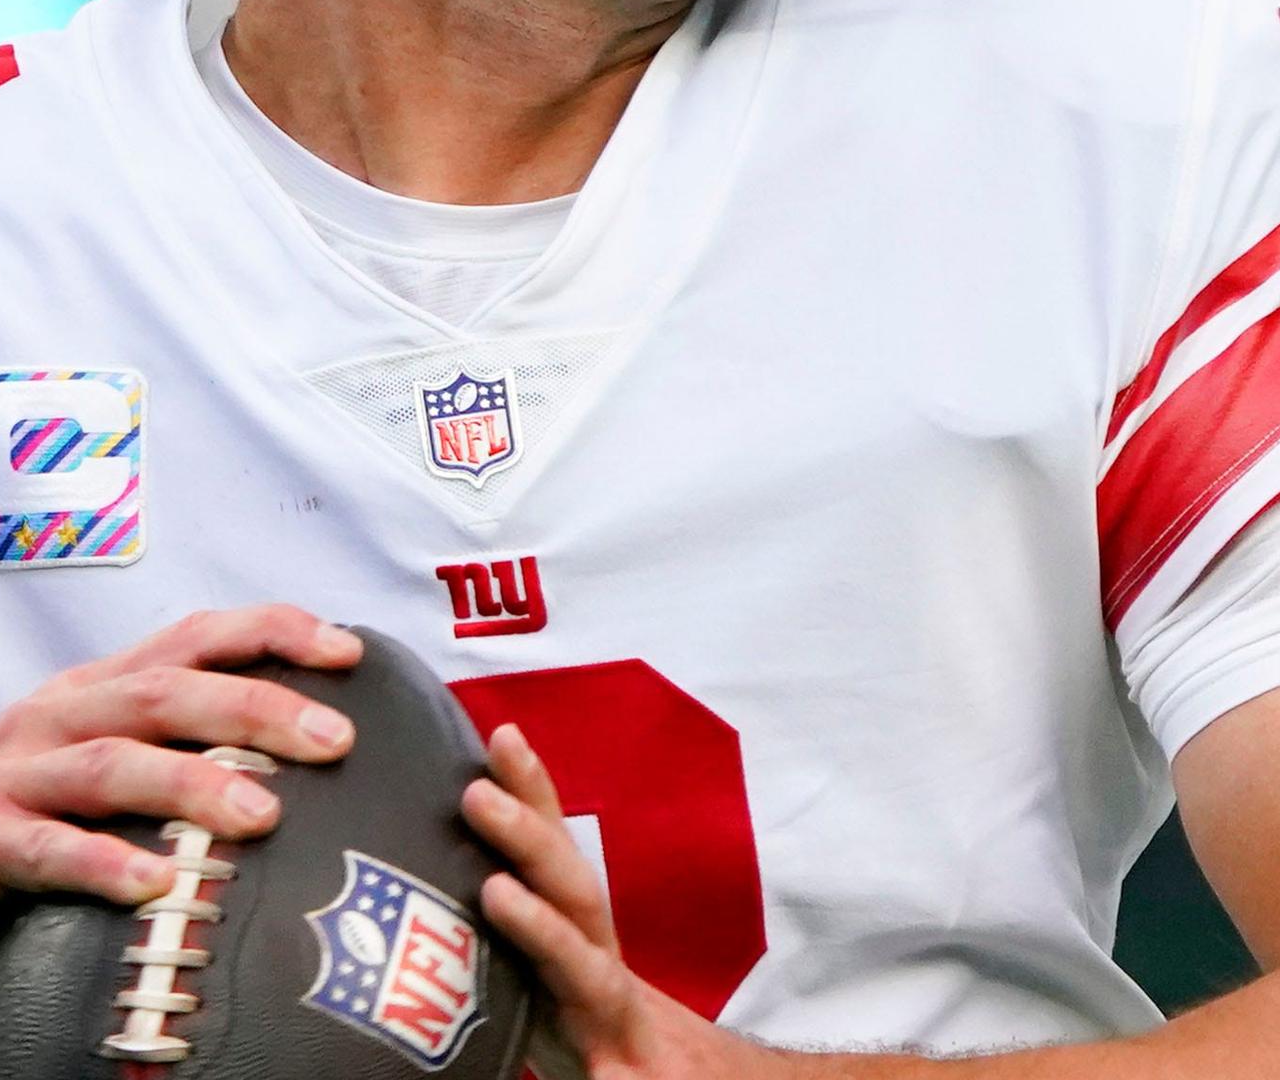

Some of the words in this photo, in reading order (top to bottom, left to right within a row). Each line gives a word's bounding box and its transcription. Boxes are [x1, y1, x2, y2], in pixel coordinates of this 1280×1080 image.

[435, 414, 508, 464] NFL
[435, 556, 548, 639] ny
[381, 915, 477, 1049] NFL
